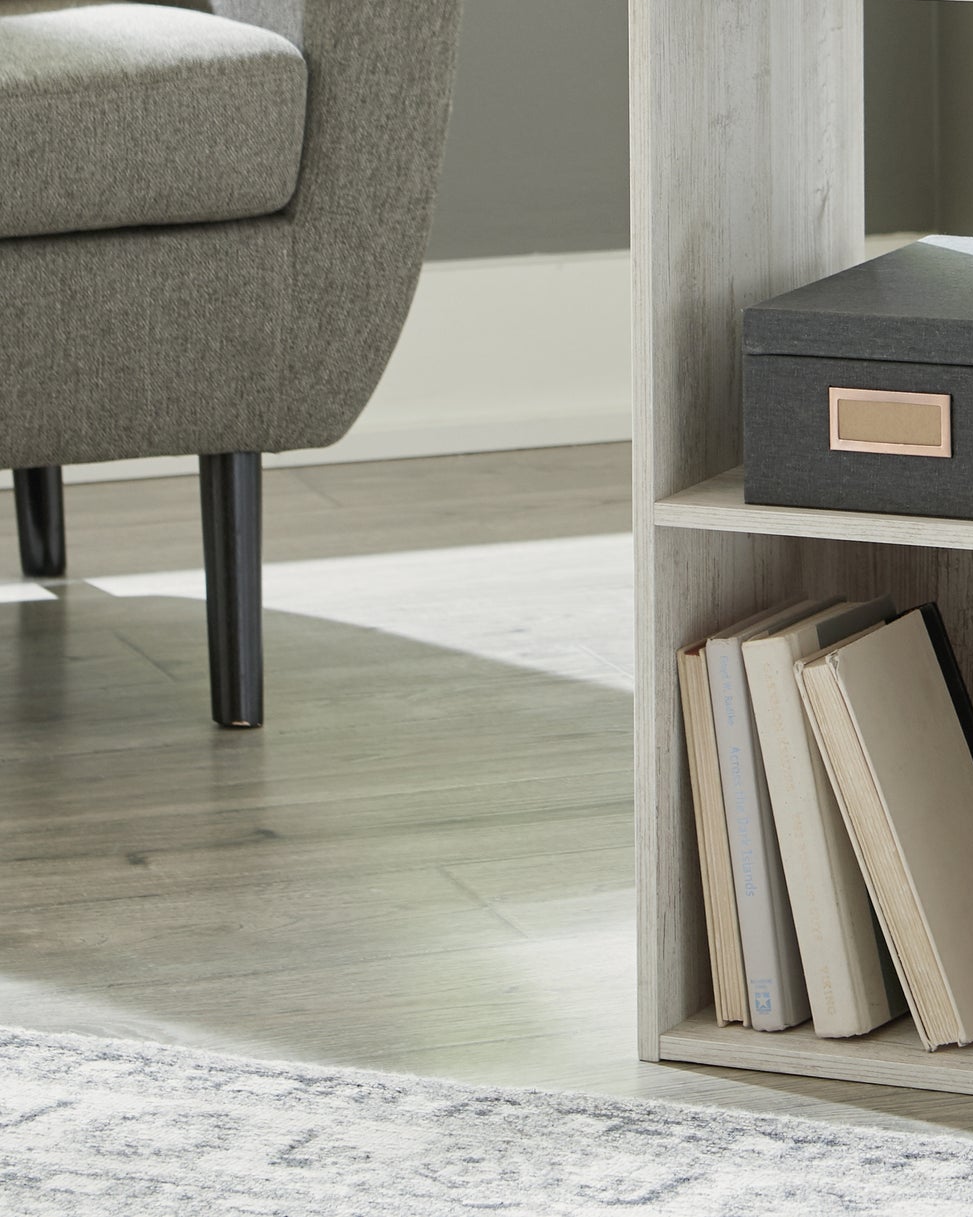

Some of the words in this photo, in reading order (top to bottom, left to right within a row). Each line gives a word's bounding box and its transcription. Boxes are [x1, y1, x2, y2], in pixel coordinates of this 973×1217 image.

[729, 746, 741, 786] Across
[741, 850, 757, 896] Islands
[820, 965, 836, 1016] VIKING
